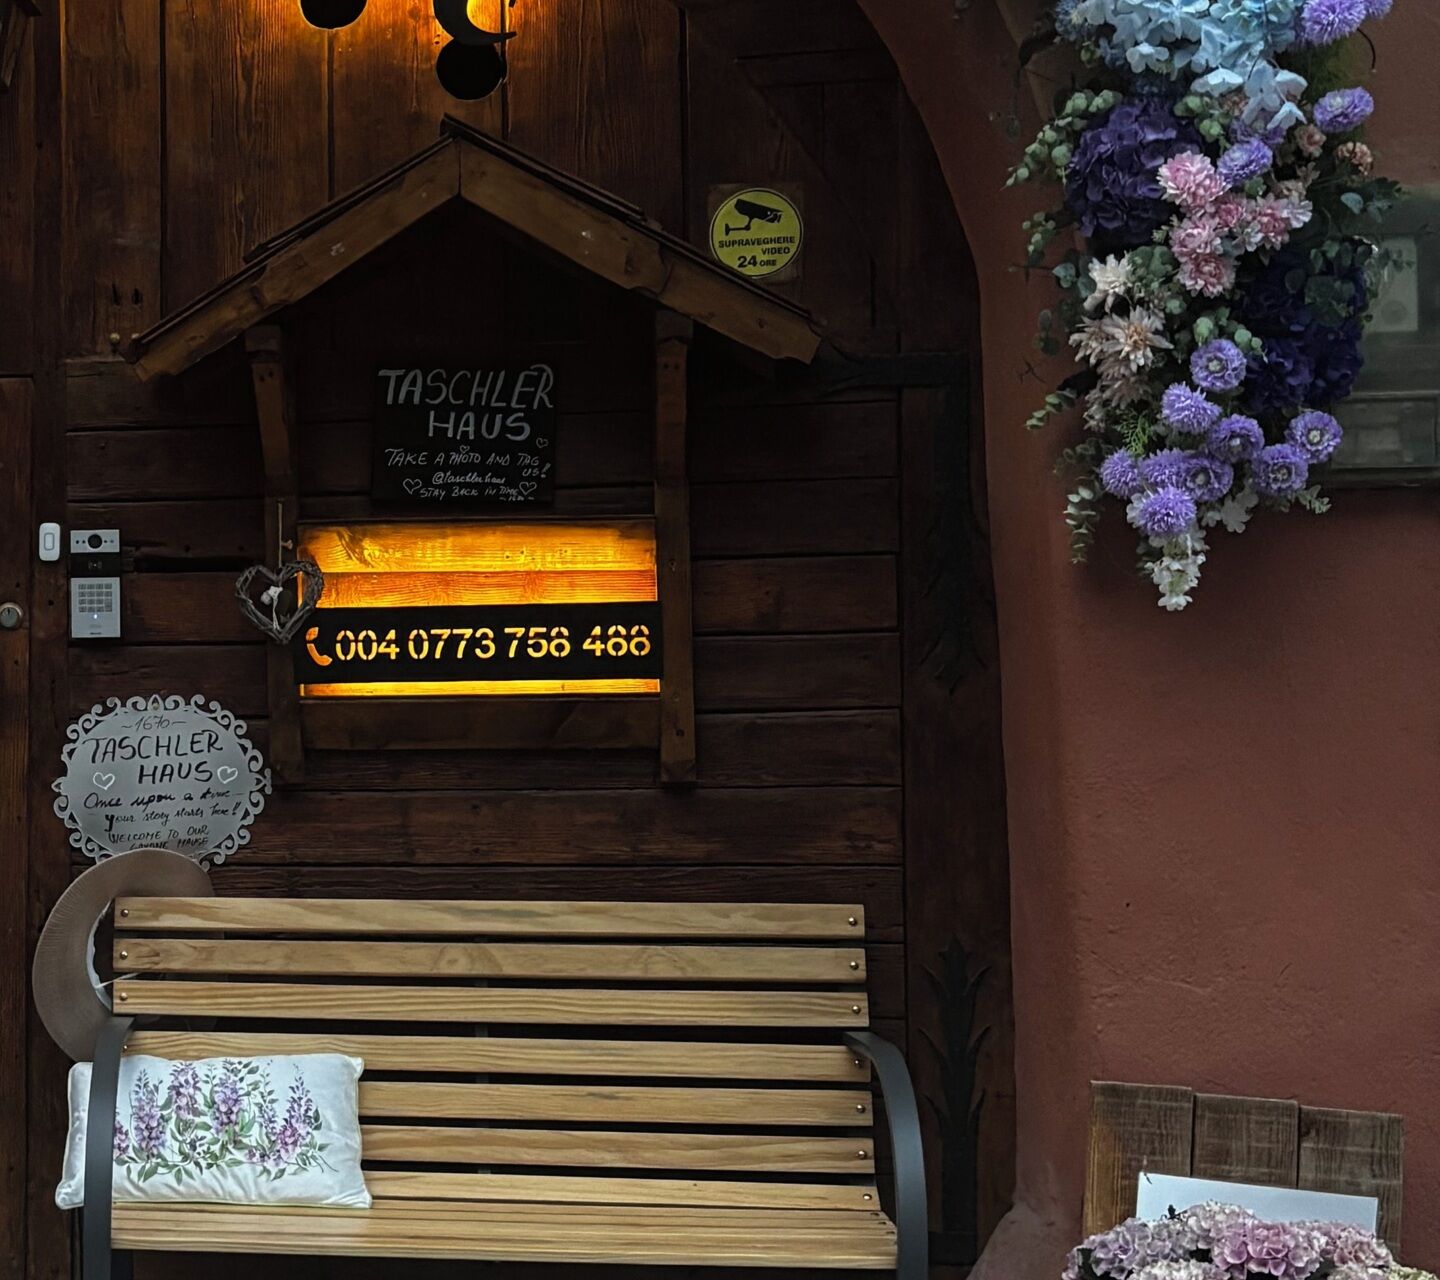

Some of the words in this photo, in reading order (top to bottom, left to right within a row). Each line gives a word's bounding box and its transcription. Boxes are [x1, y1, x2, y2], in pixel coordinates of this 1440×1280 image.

[718, 235, 796, 249] SUPRAVEGHERE
[761, 246, 791, 256] VIDEO
[737, 255, 758, 268] 24
[377, 363, 554, 410] TASCHLER
[428, 410, 531, 441] HAUS
[384, 447, 429, 466] TAKE
[433, 451, 446, 466] A
[449, 451, 481, 465] PHOTO
[486, 452, 511, 466] AND
[517, 452, 540, 466] TAG
[419, 486, 447, 500] STAY
[335, 628, 400, 662] 004
[407, 626, 497, 660] 0773
[504, 625, 572, 659] 758
[582, 623, 652, 658] 488
[82, 729, 223, 764] TASCHLER
[137, 761, 214, 785] HAUS
[183, 791, 195, 801] a
[108, 831, 162, 844] WELCOME
[168, 829, 180, 839] TO
